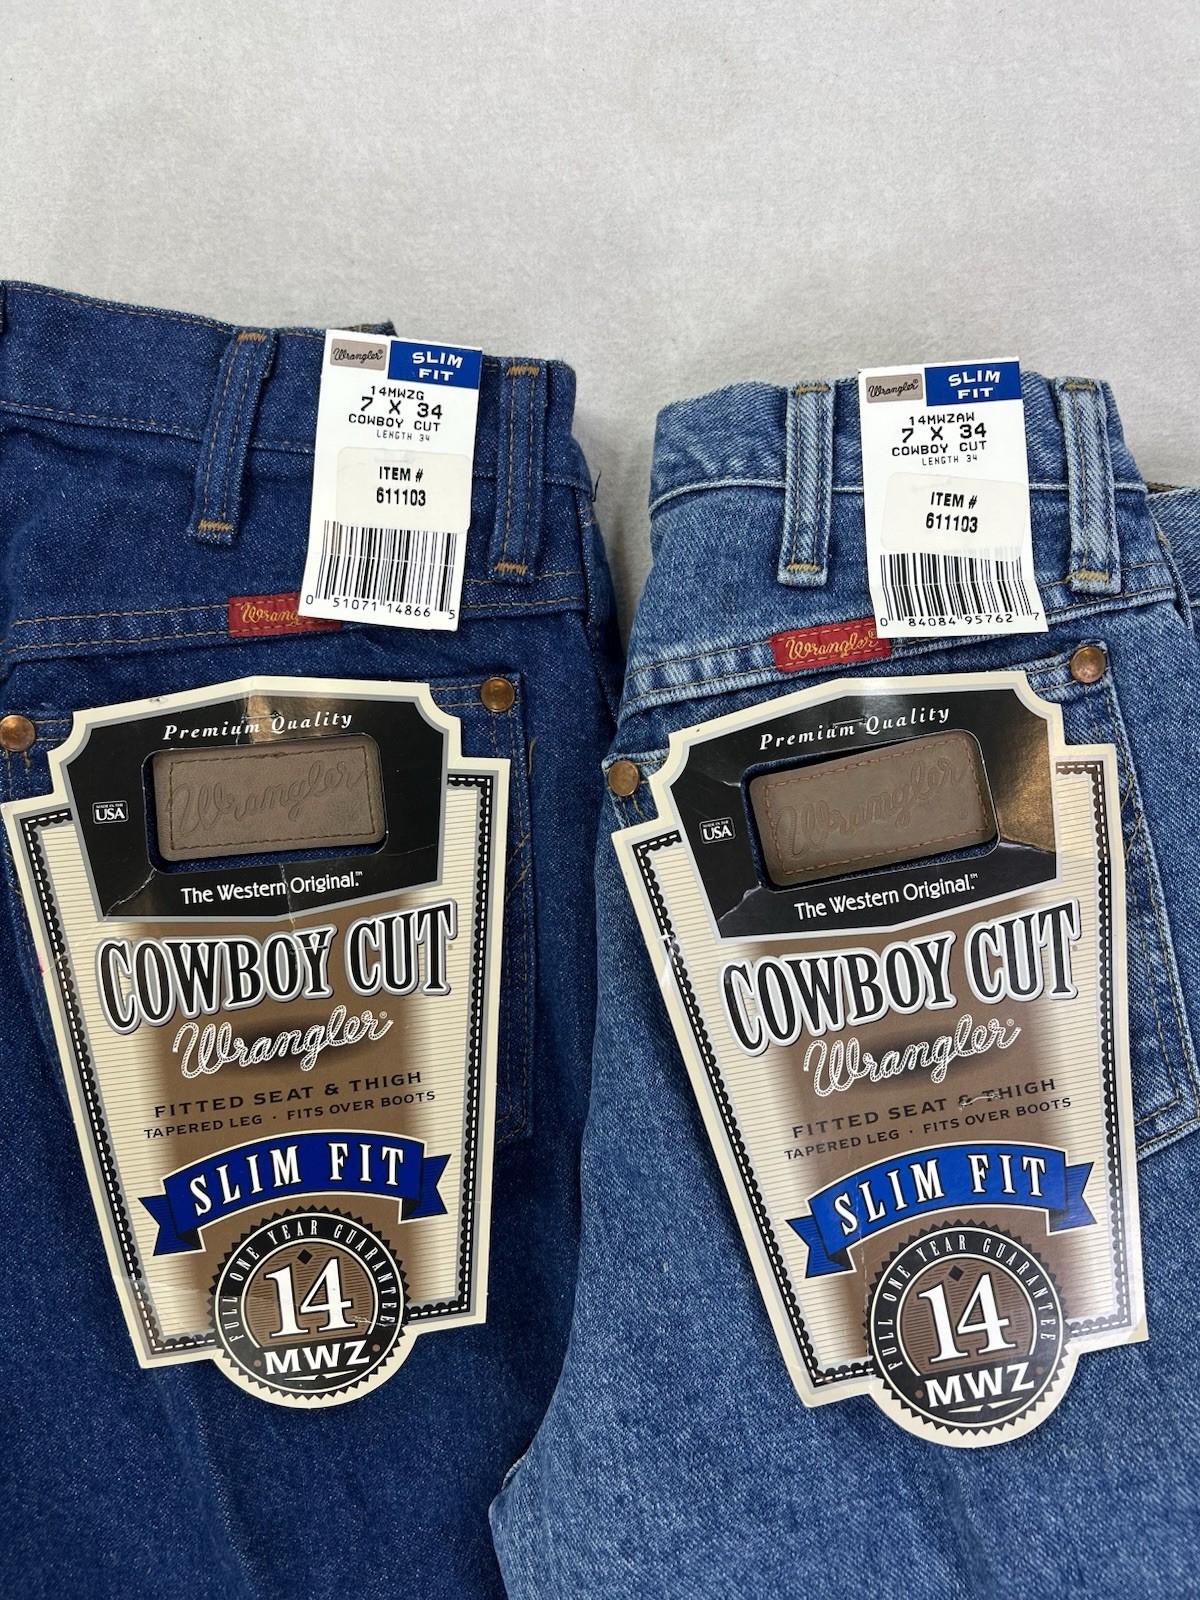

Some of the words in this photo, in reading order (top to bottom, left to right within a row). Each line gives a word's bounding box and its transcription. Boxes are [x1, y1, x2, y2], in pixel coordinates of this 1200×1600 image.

[412, 351, 463, 369] SLIM
[418, 368, 454, 382] FIT
[948, 370, 1000, 387] SLIM
[370, 385, 425, 401] 14MWZG
[957, 386, 993, 400] FIT
[360, 397, 374, 412] 7
[388, 399, 402, 415] X
[417, 402, 443, 420] 34
[908, 412, 975, 426] 14MWZAW
[348, 413, 404, 429] COWBOY
[414, 419, 441, 432] CUT
[376, 430, 413, 441] LENGTH
[419, 434, 430, 442] 34
[901, 427, 915, 443] 7
[930, 426, 944, 441] X
[960, 422, 987, 440] 34
[891, 443, 949, 457] COWBOY
[959, 440, 987, 452] CUT
[921, 455, 959, 466] LENGTH
[966, 454, 978, 462] 34
[379, 466, 411, 482] ITEM
[415, 469, 423, 482] #
[376, 487, 426, 507] 611103
[930, 491, 964, 508] ITEM
[968, 495, 978, 508] #
[925, 512, 978, 533] 611103
[240, 602, 299, 627] Wrang
[305, 594, 314, 605] 0
[333, 598, 378, 613] 51071
[387, 603, 431, 618] 14866
[448, 609, 456, 620] 5
[879, 617, 888, 627] 0
[908, 617, 956, 627] 84084
[965, 614, 1013, 625] 95762
[1033, 611, 1040, 621] 7
[162, 720, 260, 741] Premium
[270, 712, 353, 735] Quality
[759, 723, 856, 751] Premium
[864, 706, 951, 735] Quality
[95, 808, 125, 821] USA
[703, 825, 732, 841] USA
[180, 886, 214, 905] The
[216, 881, 287, 901] Western
[794, 900, 827, 921] The
[828, 888, 899, 915] Western
[97, 927, 336, 1033] COWBOY
[719, 932, 956, 1055] COWBOY
[154, 1095, 244, 1118] FITTED
[254, 1086, 314, 1106] SEAT
[324, 1083, 339, 1096] &
[348, 1071, 422, 1093] THIGH
[792, 1111, 879, 1138] FITTED
[888, 1098, 947, 1119] SEAT
[982, 1078, 1056, 1101] THIGH
[144, 1119, 223, 1139] TAPERED
[229, 1114, 263, 1128] LEG
[287, 1106, 324, 1121] FITS
[329, 1098, 375, 1115] OVER
[380, 1090, 436, 1108] BOOTS
[784, 1136, 862, 1160] TAPERED
[867, 1129, 900, 1144] LEG
[923, 1117, 960, 1134] FITS
[965, 1108, 1010, 1126] OVER
[1016, 1097, 1072, 1117] BOOTS
[188, 1145, 302, 1217] SLIM
[328, 1142, 404, 1186] FIT
[834, 1159, 944, 1235] SLIM
[968, 1154, 1046, 1197] FIT
[267, 1219, 318, 1246] YEAR
[916, 1234, 967, 1263] YEAR
[229, 1246, 260, 1282] ONE
[333, 1223, 397, 1323] GUARANTEE
[882, 1264, 911, 1301] ONE
[983, 1238, 1056, 1341] GUARANTEE
[263, 1256, 358, 1338] 14
[222, 1296, 245, 1343] FULL
[918, 1272, 1016, 1363] 14
[263, 1339, 371, 1376] MWZ
[877, 1318, 903, 1371] FULL
[924, 1361, 1035, 1408] MWZ
